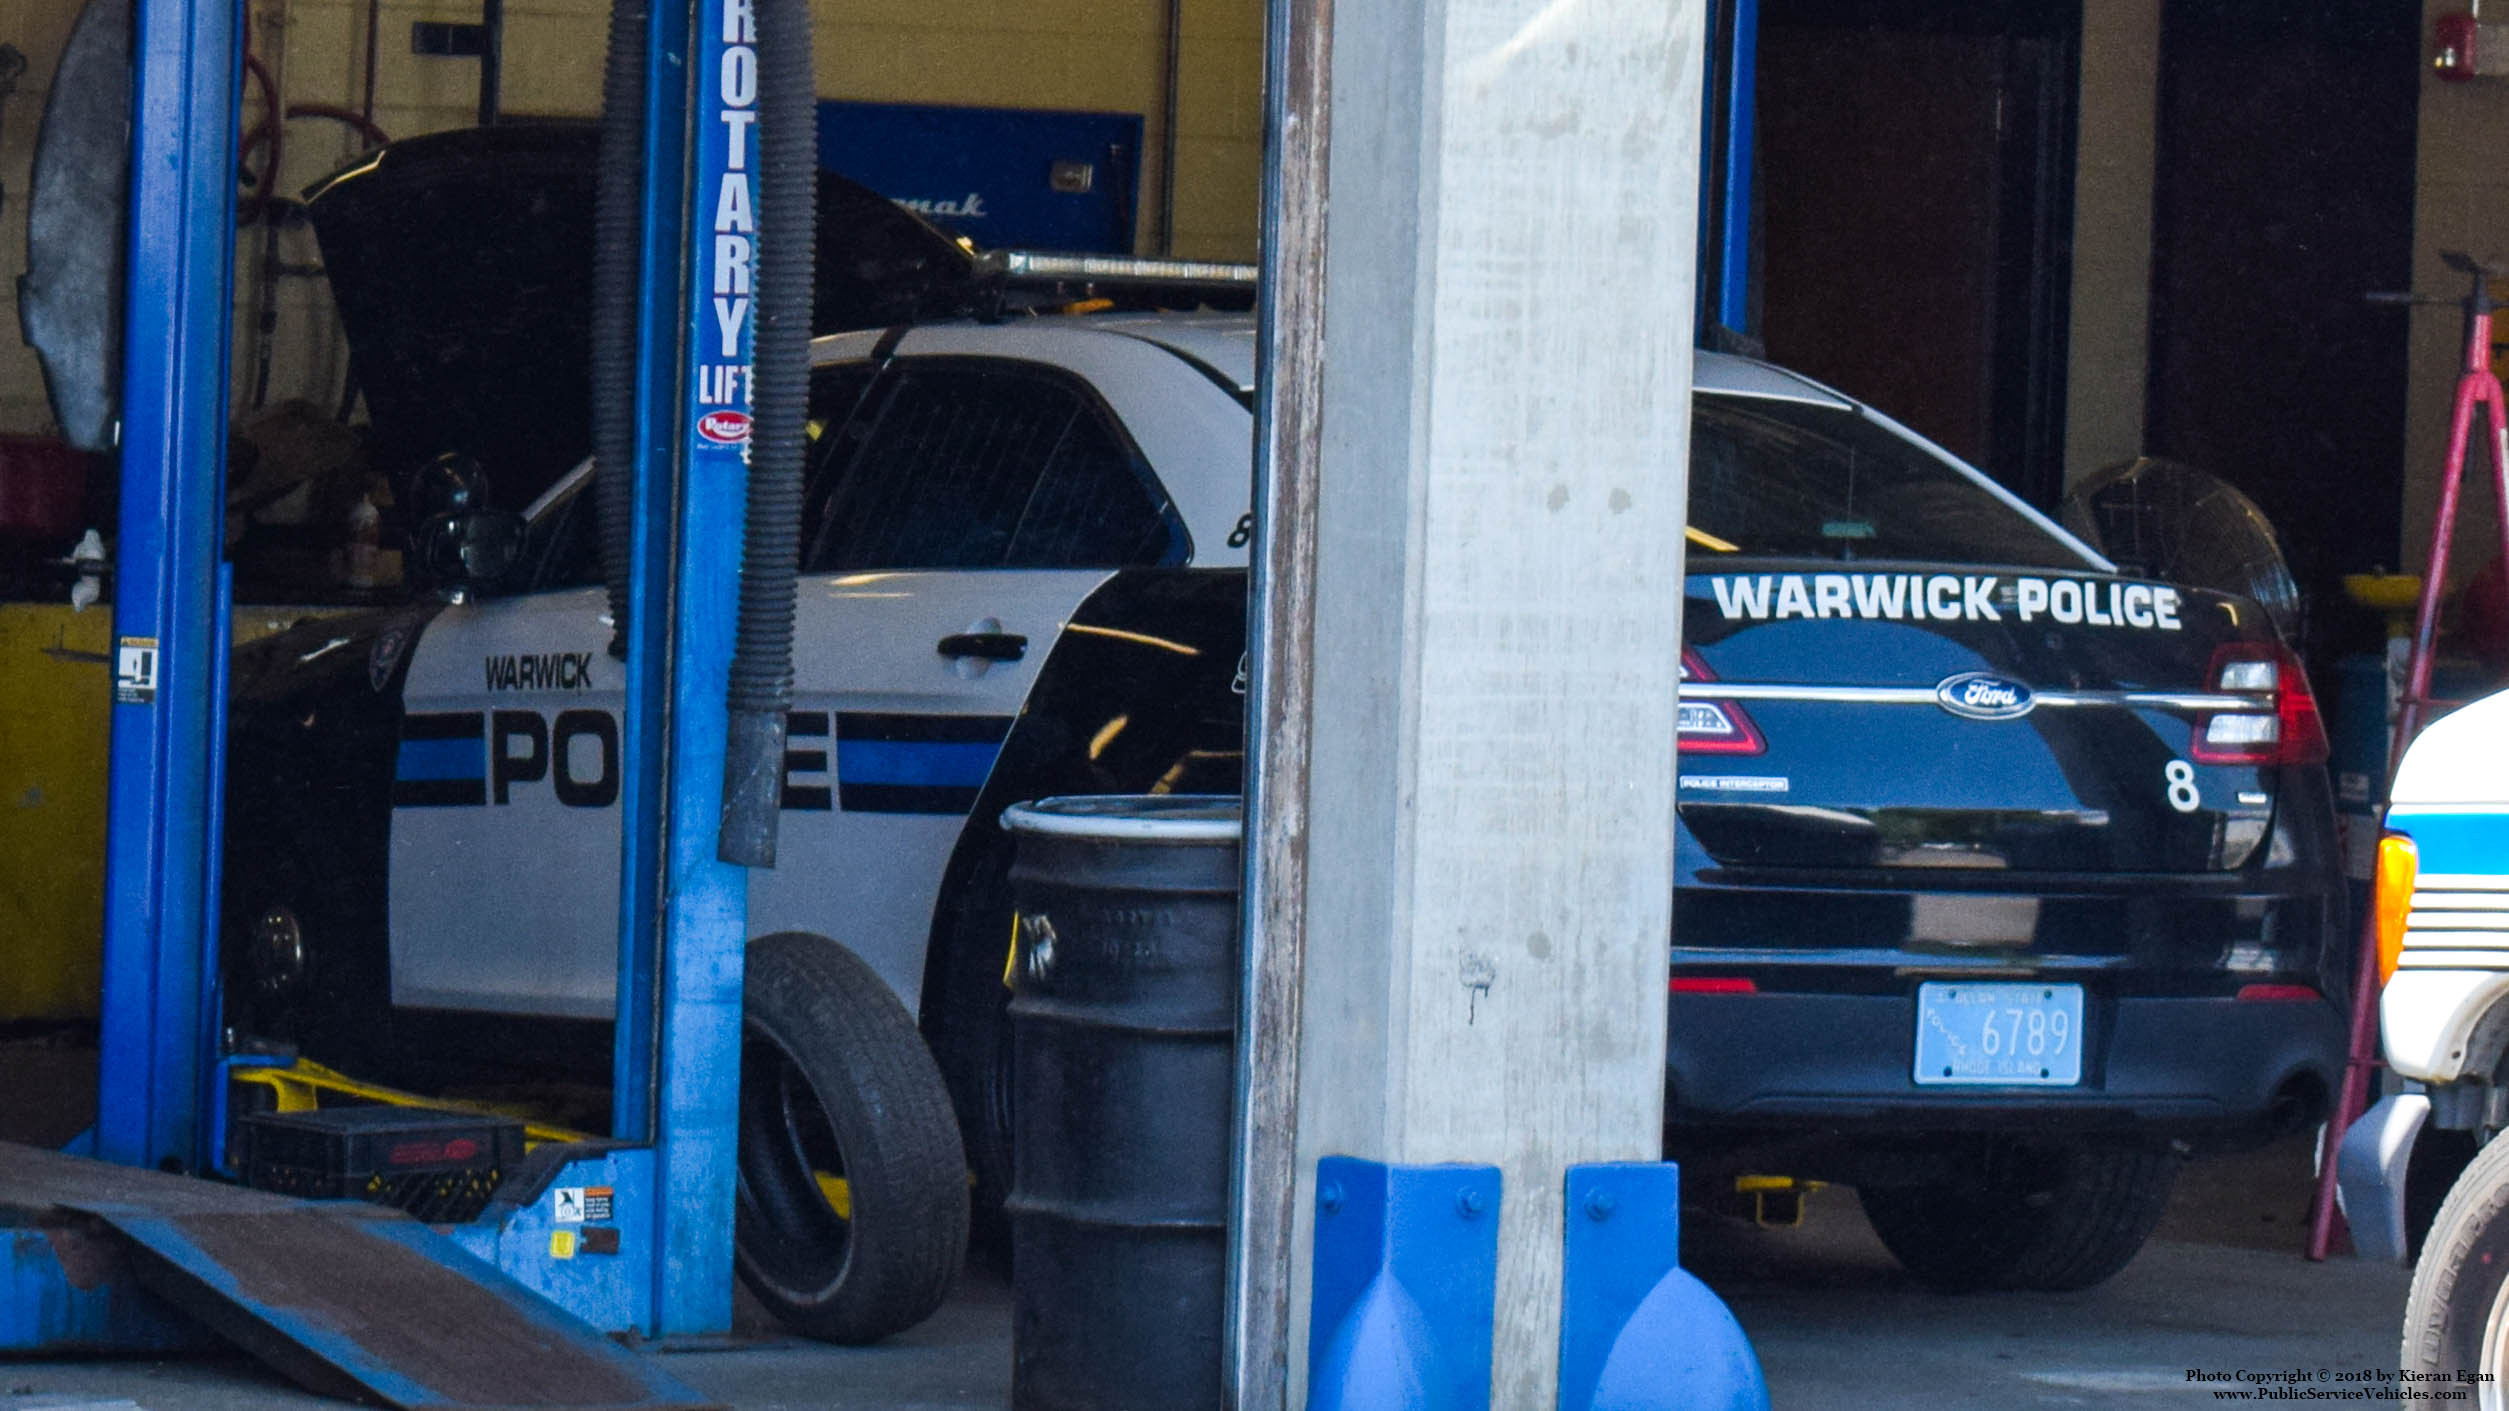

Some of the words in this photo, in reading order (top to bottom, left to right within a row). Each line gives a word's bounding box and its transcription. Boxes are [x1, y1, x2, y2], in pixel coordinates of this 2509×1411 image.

[713, 0, 757, 356] ROTARY
[699, 365, 754, 405] LIFT
[1712, 574, 2002, 620] WARWICK
[2018, 578, 2182, 630] POLICE
[485, 652, 594, 691] WARWICK
[1964, 679, 2017, 705] Ford
[2165, 759, 2200, 812] 8
[1982, 1009, 2068, 1056] 6789
